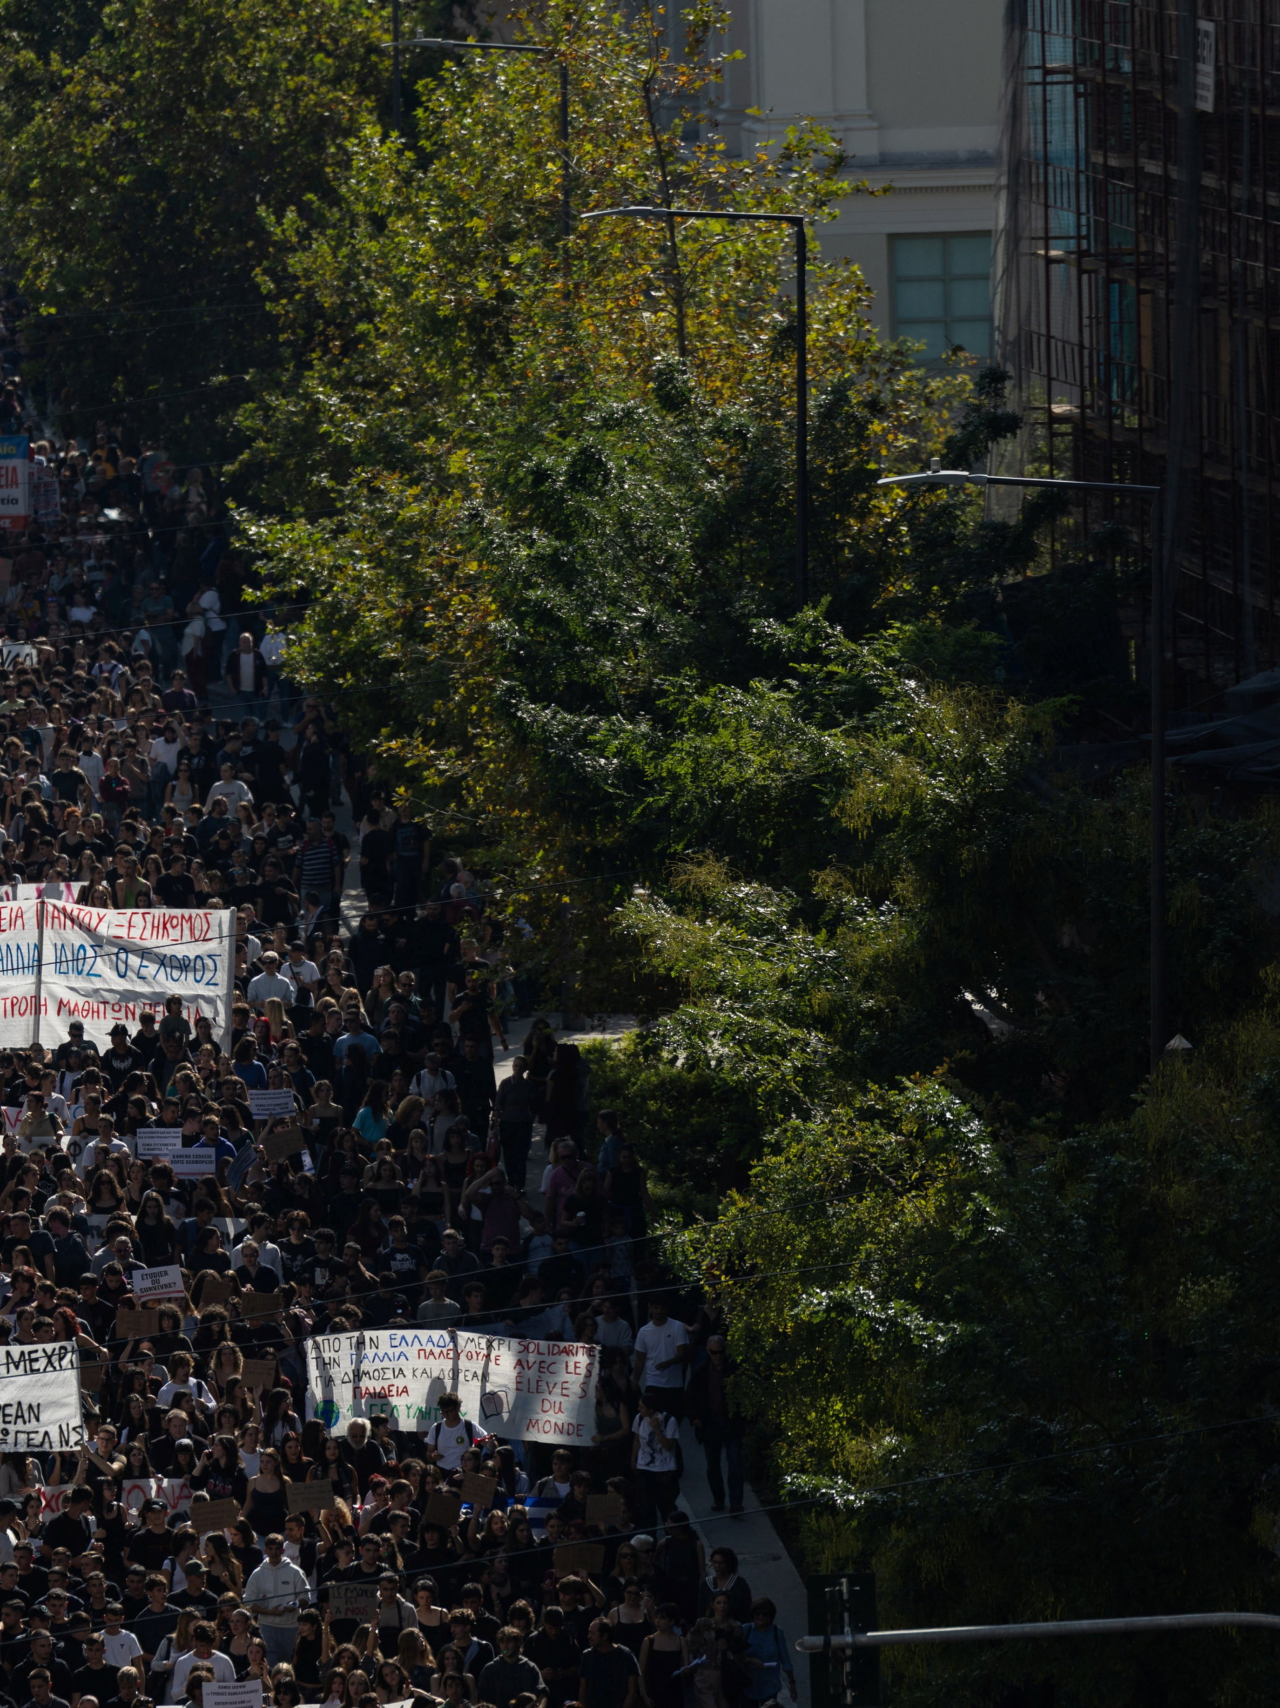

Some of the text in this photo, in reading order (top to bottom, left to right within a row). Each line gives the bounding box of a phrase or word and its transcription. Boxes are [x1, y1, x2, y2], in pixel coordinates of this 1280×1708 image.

[35, 900, 107, 933] ΠΑΝΤΟΥ
[111, 911, 213, 943] ΞΕΣΗΚΩΜΟΣ
[54, 942, 103, 978] ΙΔΙΟΣ
[116, 947, 129, 980] Ο
[135, 950, 222, 987] ΕΧΘΡΟΣ
[57, 998, 137, 1022] ΜΑΘΗΤΩΝ
[142, 1001, 202, 1026] ΠΕΙΙΑ
[140, 1269, 169, 1282] ÉTUDIER
[151, 1278, 161, 1286] OU
[139, 1281, 177, 1294] SURVIVRE?
[310, 1333, 512, 1354] ΑΠΟ ΤΗΝ ΕΛΛΑΔΑ ΜΕΧΡΙ
[6, 1345, 76, 1374] ΜΕΧΡΙ
[311, 1348, 502, 1372] ΤΗΝ ΓΑΛΛΙΑ ΠΑΛΕΥΟΥΜΕ
[513, 1359, 594, 1378] AVEC LES
[315, 1367, 491, 1389] ΓΙΑ ΔΗΜΟΣΙΑ ΚΑΙ ΔΩΡΕΑΝ
[352, 1383, 410, 1401] ΠΑΙΔΕΙΑ
[405, 1403, 468, 1422] ΥΜΗΤΥ
[541, 1398, 566, 1415] DU
[526, 1418, 586, 1438] MONDE
[14, 1430, 54, 1450] ΓΕΛ
[332, 1586, 376, 1600] LE MONDE
[344, 1596, 358, 1606] EST
[344, 1605, 369, 1617] NOUS
